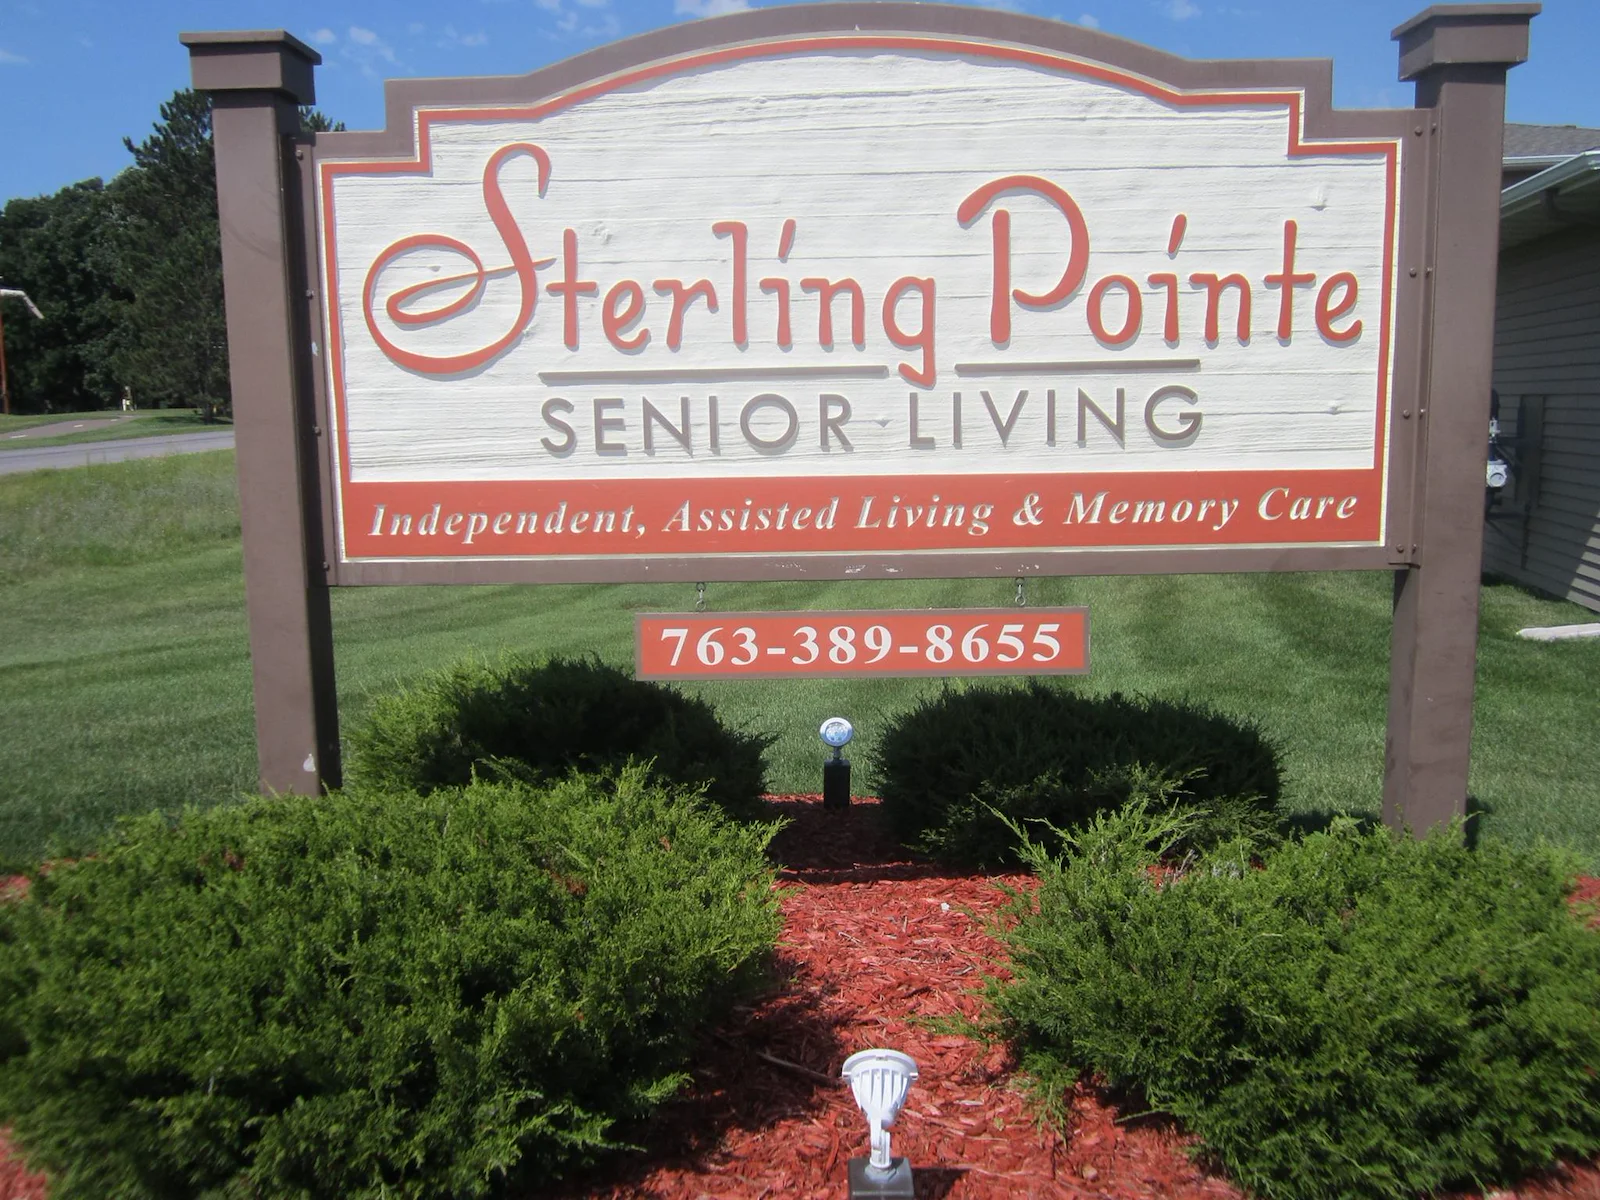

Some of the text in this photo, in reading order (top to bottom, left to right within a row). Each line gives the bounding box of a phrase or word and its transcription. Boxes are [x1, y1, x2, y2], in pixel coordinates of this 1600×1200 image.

[363, 142, 1363, 388] Sterling Pointe
[540, 385, 1202, 455] SENIOR LIVING
[368, 487, 1359, 544] Independent, Assisted Living & Memory Care
[660, 623, 1062, 667] 763-389-8655
